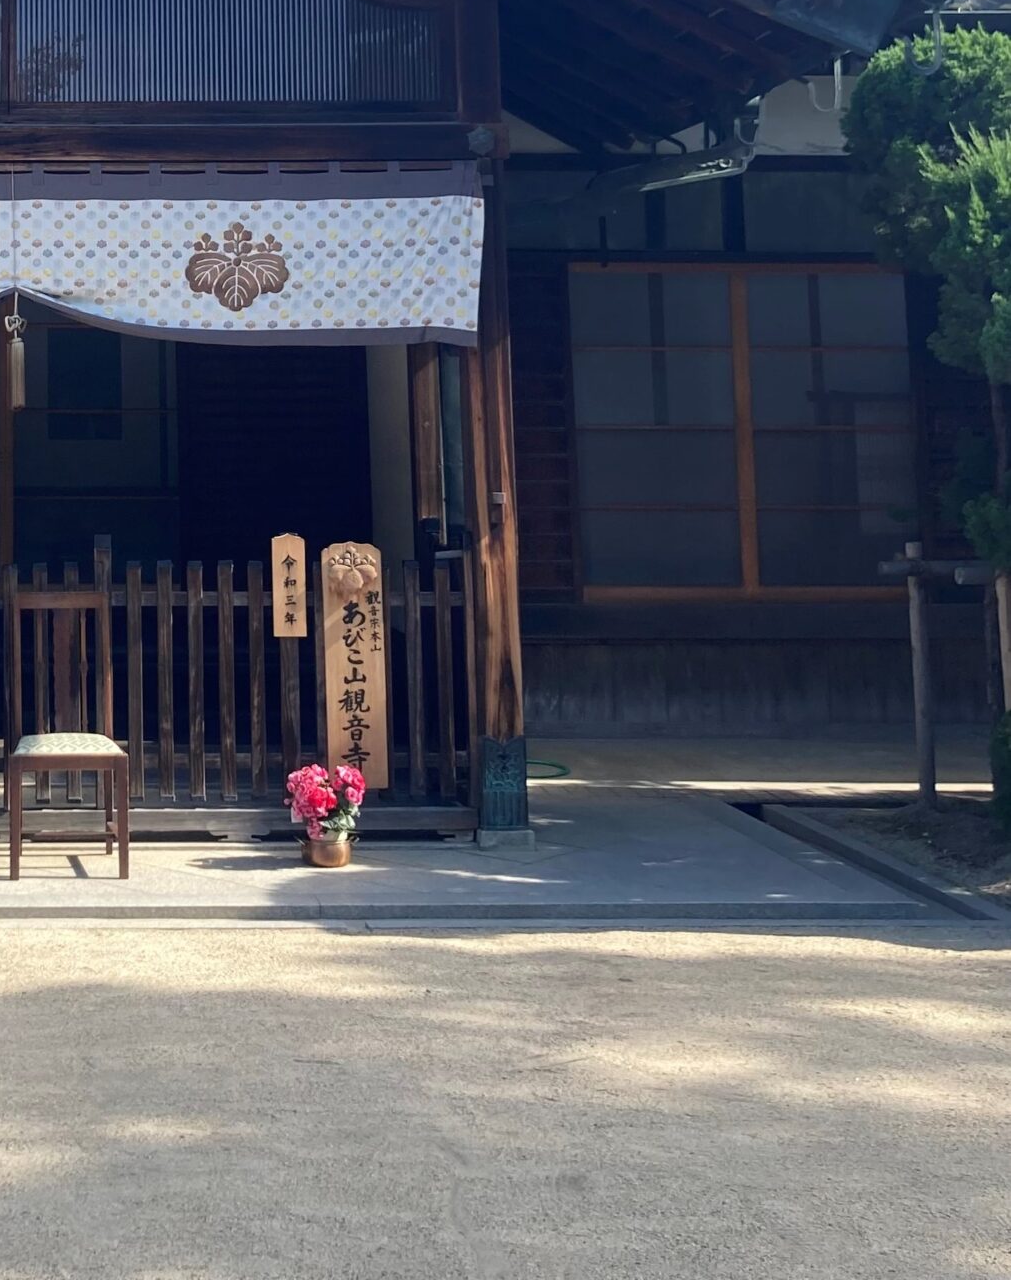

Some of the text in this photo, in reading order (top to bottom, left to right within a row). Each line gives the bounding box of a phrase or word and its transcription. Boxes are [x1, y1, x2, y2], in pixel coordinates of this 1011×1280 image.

[281, 554, 298, 626] 令和三年
[365, 590, 382, 652] 観音宗本山
[338, 600, 370, 773] あびこ山観音寺
